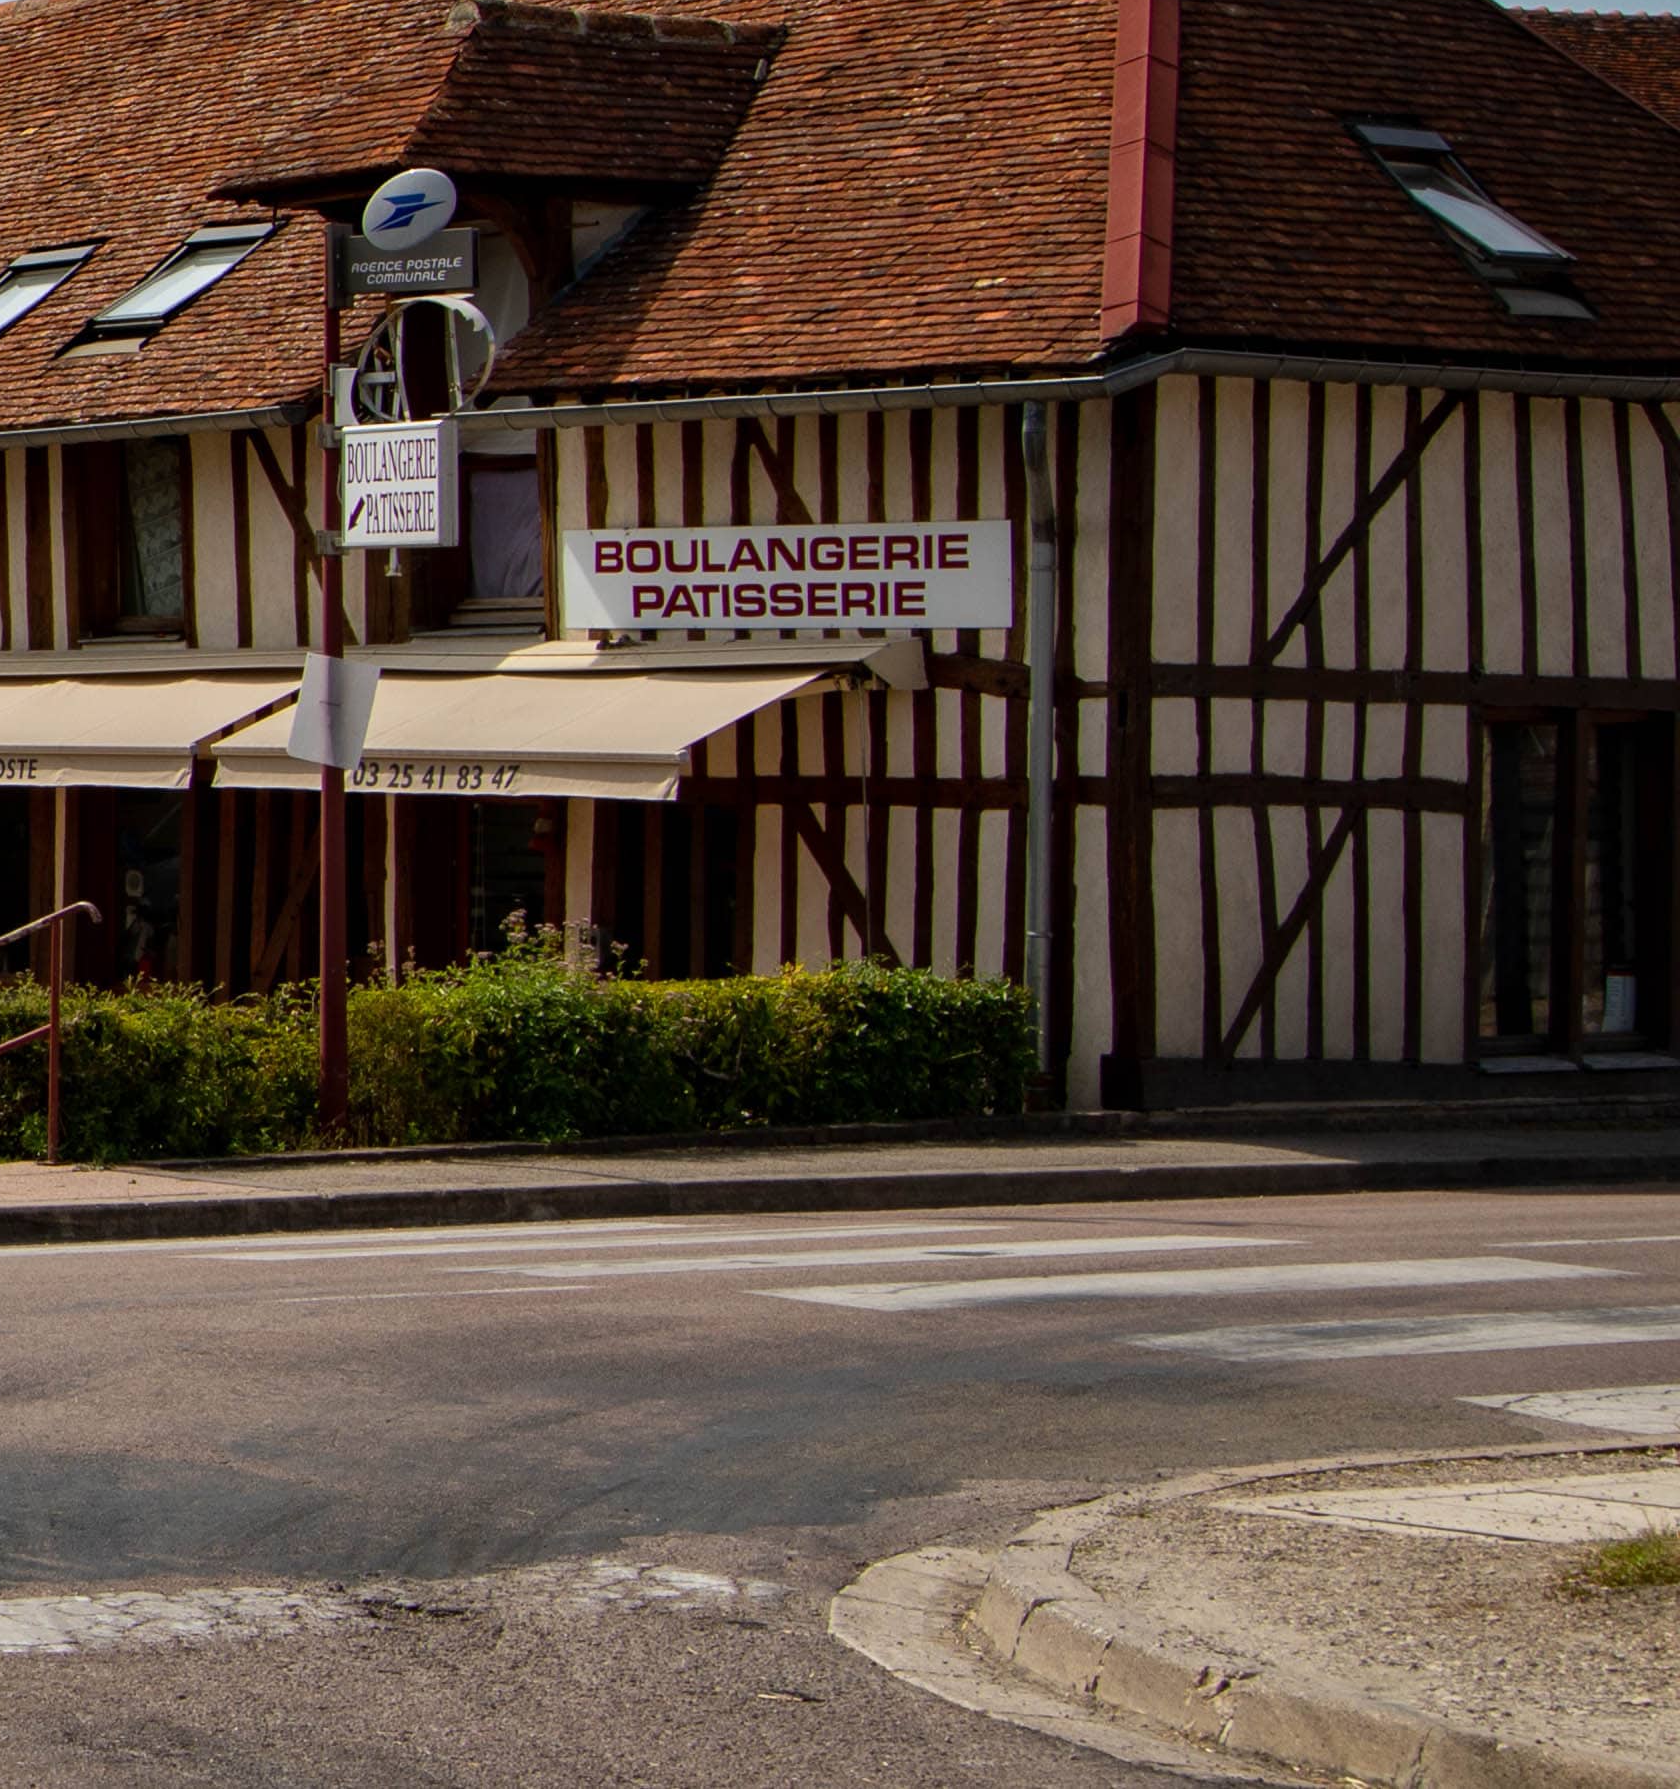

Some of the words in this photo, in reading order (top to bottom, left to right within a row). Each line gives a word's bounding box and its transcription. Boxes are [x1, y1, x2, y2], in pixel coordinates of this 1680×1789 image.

[351, 260, 403, 273] AGENCE
[406, 257, 463, 270] POSTALE
[366, 270, 447, 285] COMMUNALE
[347, 438, 436, 483] BOULANGERIE
[366, 491, 435, 534] PATISSERIE
[594, 534, 969, 574] BOULANGERIE
[632, 581, 926, 619] PATISSERIE
[353, 762, 380, 787] 03
[387, 763, 415, 788] 25
[422, 765, 446, 789] 41
[457, 765, 484, 789] 83
[491, 765, 520, 789] 47
